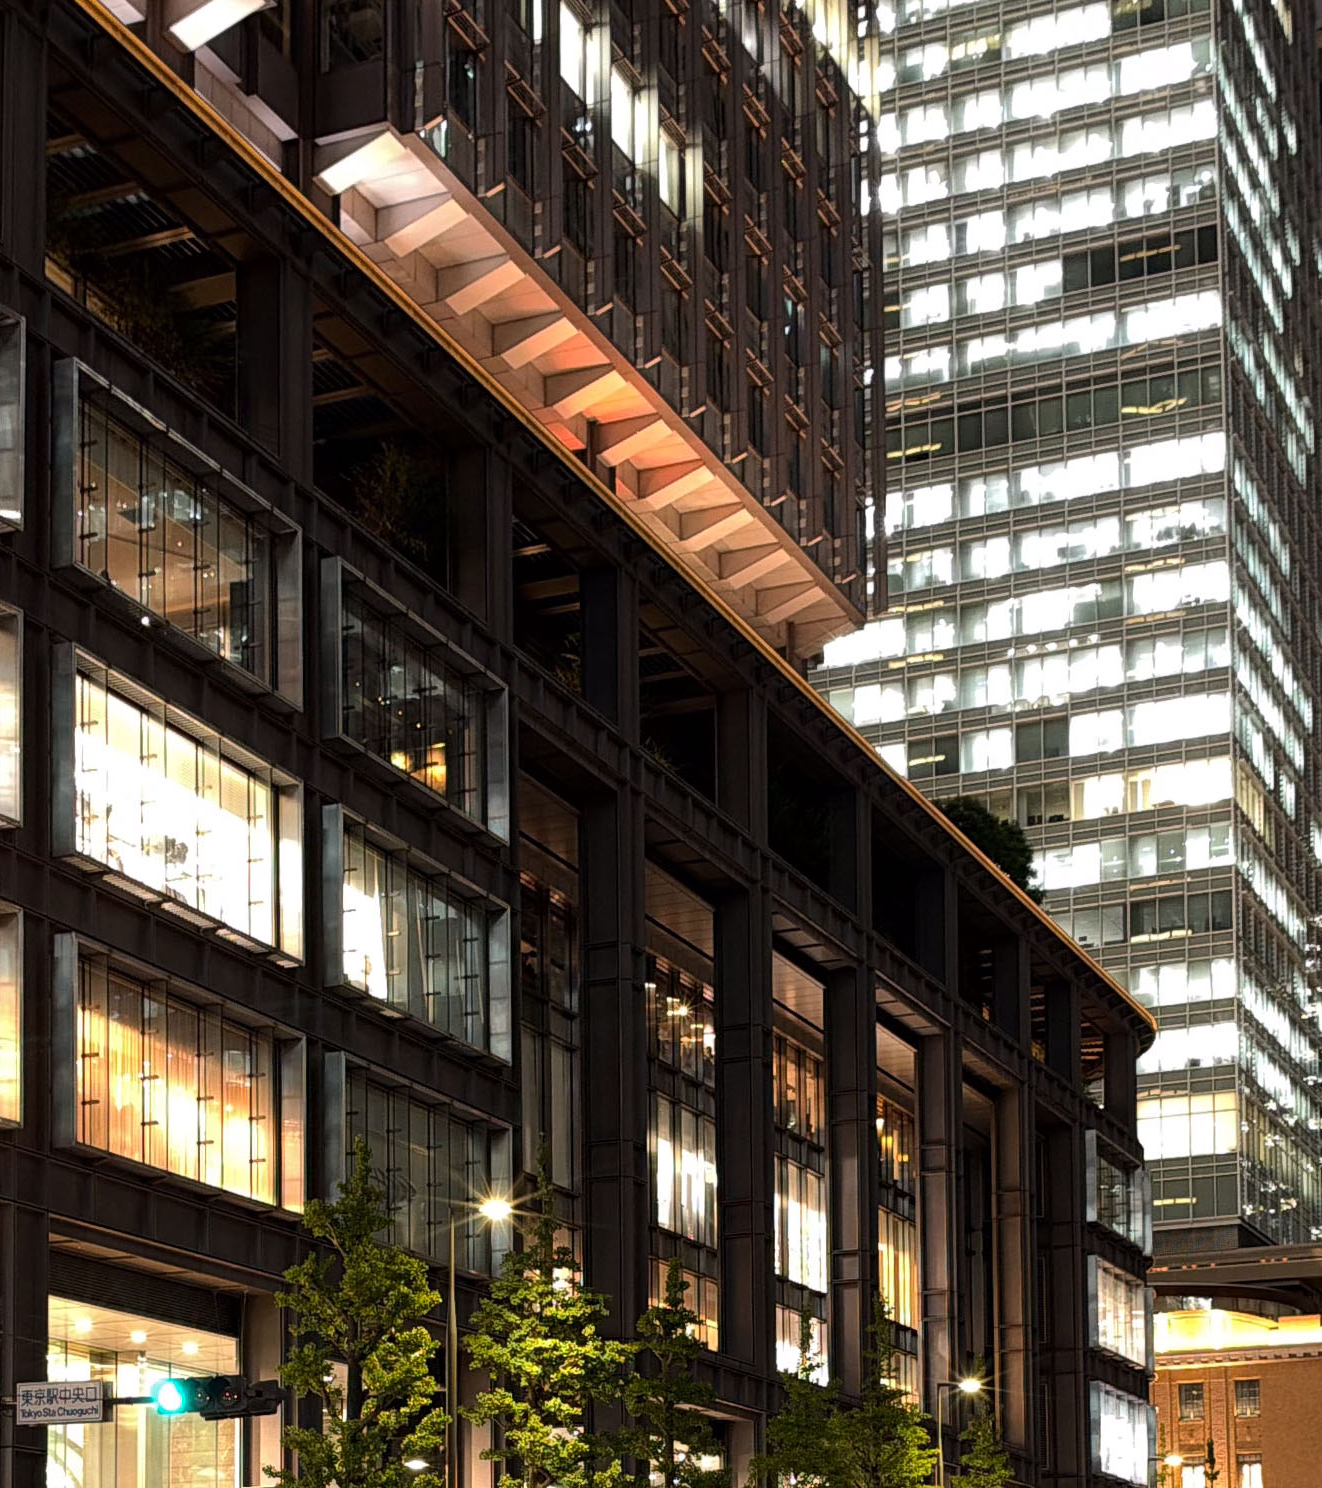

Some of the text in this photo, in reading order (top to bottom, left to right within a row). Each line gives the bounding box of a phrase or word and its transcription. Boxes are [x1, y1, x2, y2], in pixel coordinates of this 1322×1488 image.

[21, 1386, 97, 1407] 東京駅中央口
[21, 1408, 42, 1419] Tokyo
[57, 1404, 99, 1417] Chuoguchi
